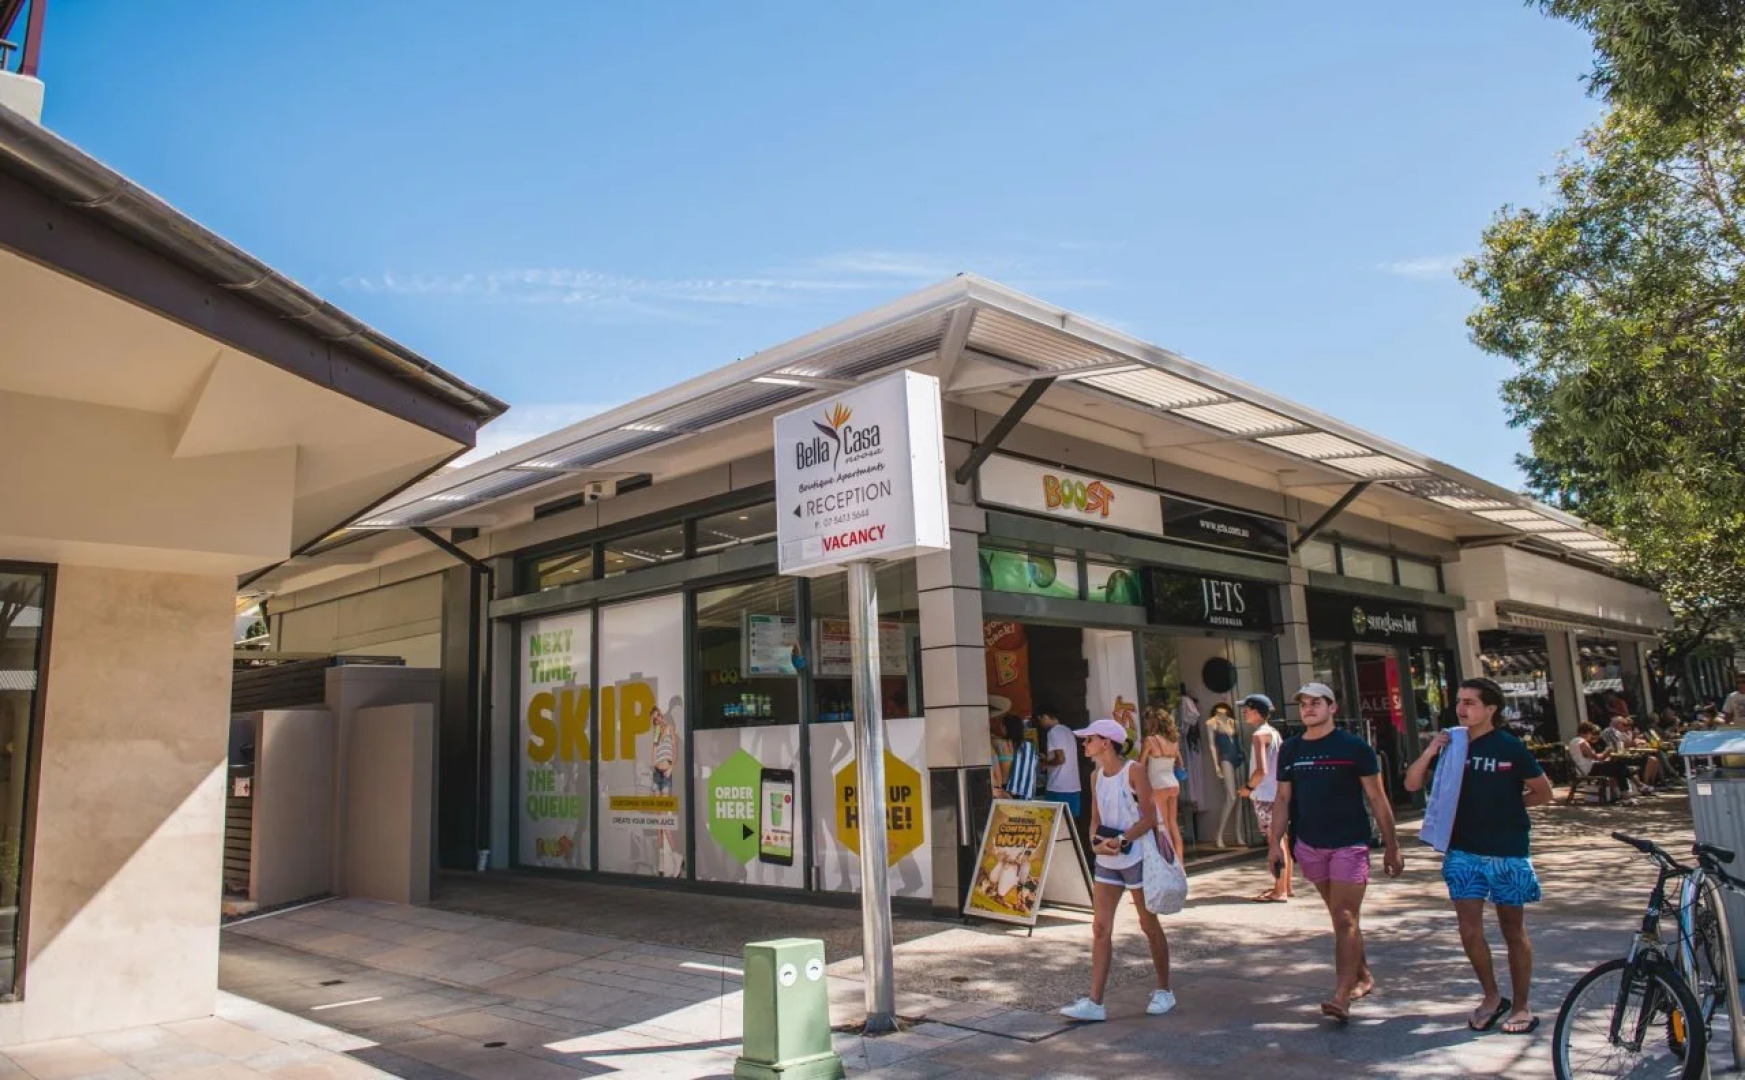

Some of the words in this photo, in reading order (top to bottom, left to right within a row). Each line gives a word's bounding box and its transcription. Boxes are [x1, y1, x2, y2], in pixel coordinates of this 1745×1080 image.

[796, 437, 829, 470] Bella
[844, 425, 880, 455] Casa
[799, 478, 833, 493] Boutique
[837, 462, 885, 483] Apartments
[806, 480, 891, 517] RECEPTION
[1043, 474, 1114, 517] BOOST
[824, 525, 886, 552] VACANCY
[1201, 578, 1245, 619] JETS
[1210, 616, 1243, 627] AUSTRALIA
[529, 629, 573, 656] NEXT
[527, 682, 656, 763] SKIP
[1472, 756, 1496, 772] TH
[526, 768, 556, 792] THE
[715, 786, 754, 800] ORDER
[889, 785, 912, 803] UP
[526, 794, 582, 822] QUEUE
[612, 816, 631, 825] CREATE
[632, 817, 646, 825] YOUR
[659, 818, 675, 827] JUICE
[715, 801, 755, 819] HERE
[845, 805, 912, 830] HE!
